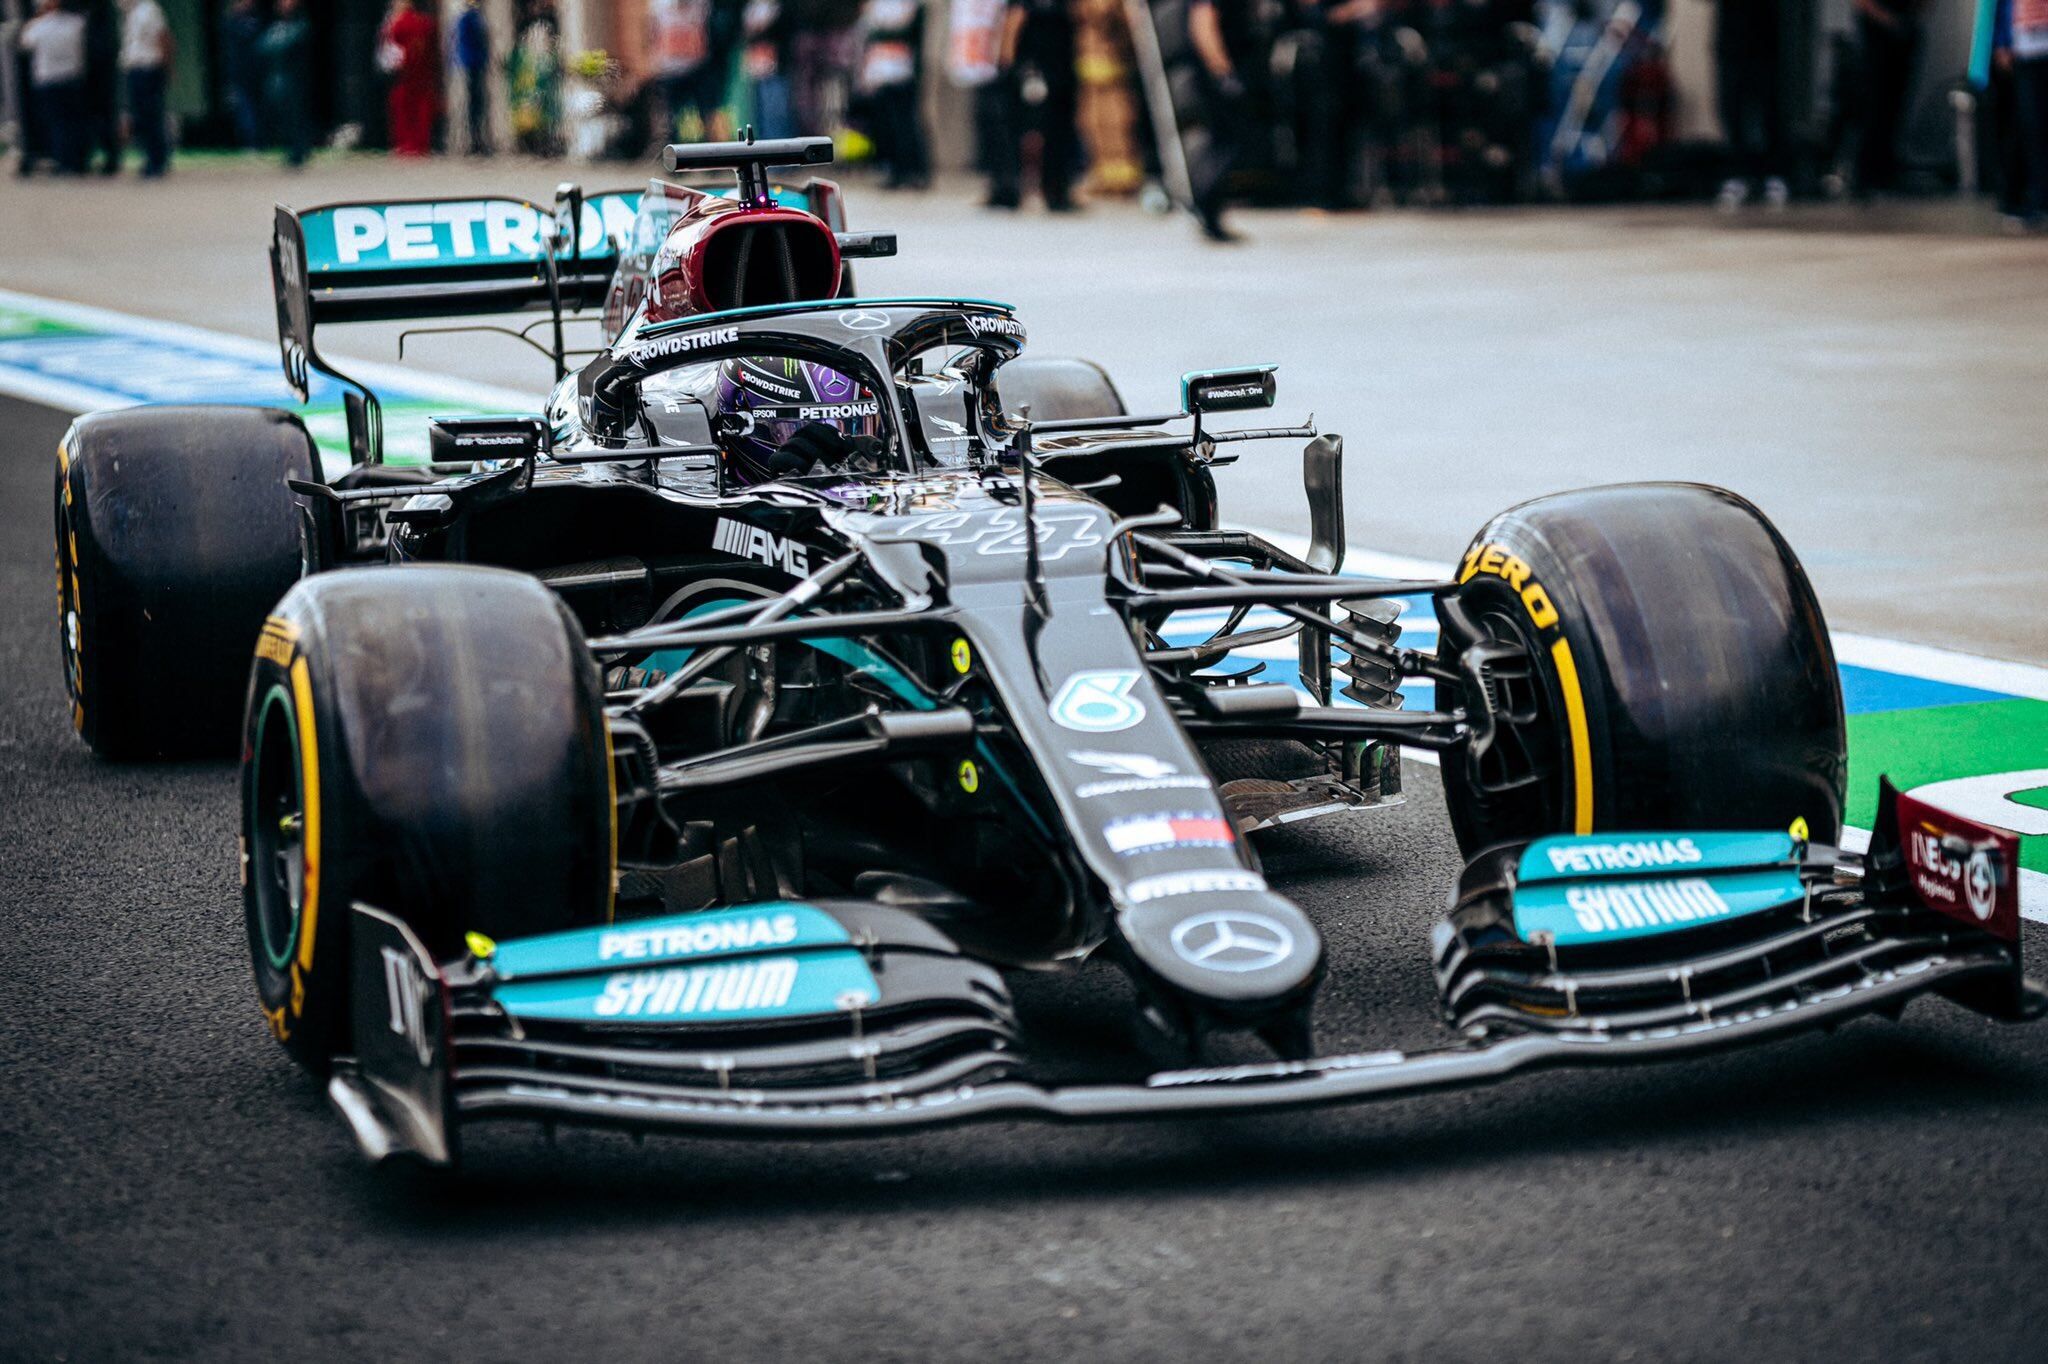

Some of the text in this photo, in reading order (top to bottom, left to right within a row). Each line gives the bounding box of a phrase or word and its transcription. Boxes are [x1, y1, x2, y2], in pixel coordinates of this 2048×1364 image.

[333, 195, 640, 264] PETRON
[633, 327, 739, 361] CROWDSTRIKE
[971, 315, 1026, 336] CROWDST
[742, 371, 801, 399] CROWDSTRIKE
[753, 409, 777, 418] EPSON
[800, 402, 878, 420] PETRONAS
[747, 526, 810, 580] AMG
[1460, 543, 1559, 629] ZERO
[1547, 838, 1702, 873] PETRONAS
[1565, 877, 1730, 932] SYNTIUM
[600, 914, 798, 960] PETRONAS
[594, 957, 799, 1015] SYNTIUM
